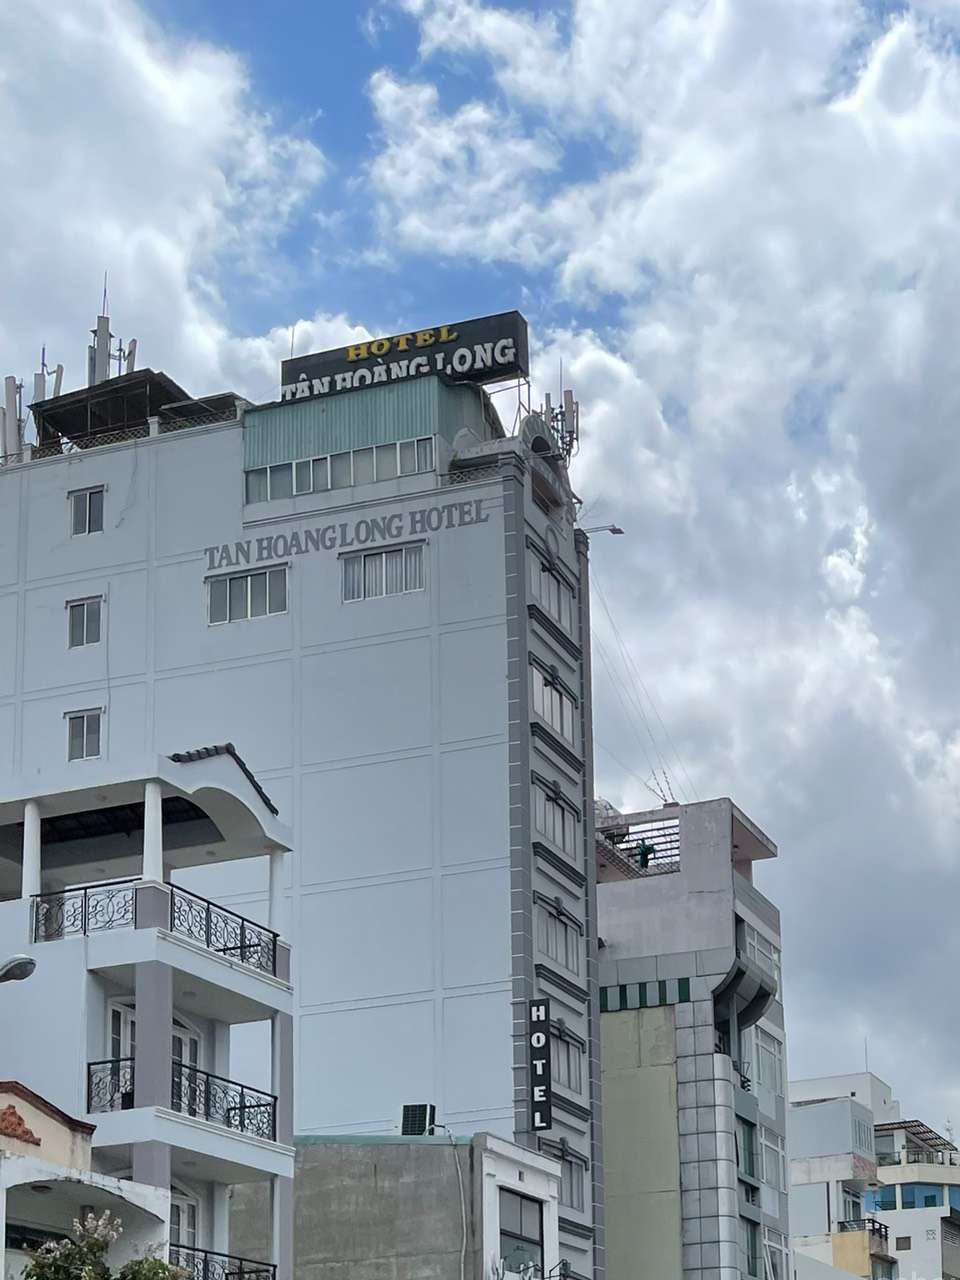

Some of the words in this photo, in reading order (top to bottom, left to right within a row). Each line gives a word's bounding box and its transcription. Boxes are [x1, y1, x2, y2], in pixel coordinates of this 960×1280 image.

[347, 326, 458, 362] HOTEL
[436, 338, 518, 376] LONG
[204, 539, 251, 570] TAN
[409, 499, 490, 535] HOTEL
[531, 1005, 547, 1127] HOTEL
